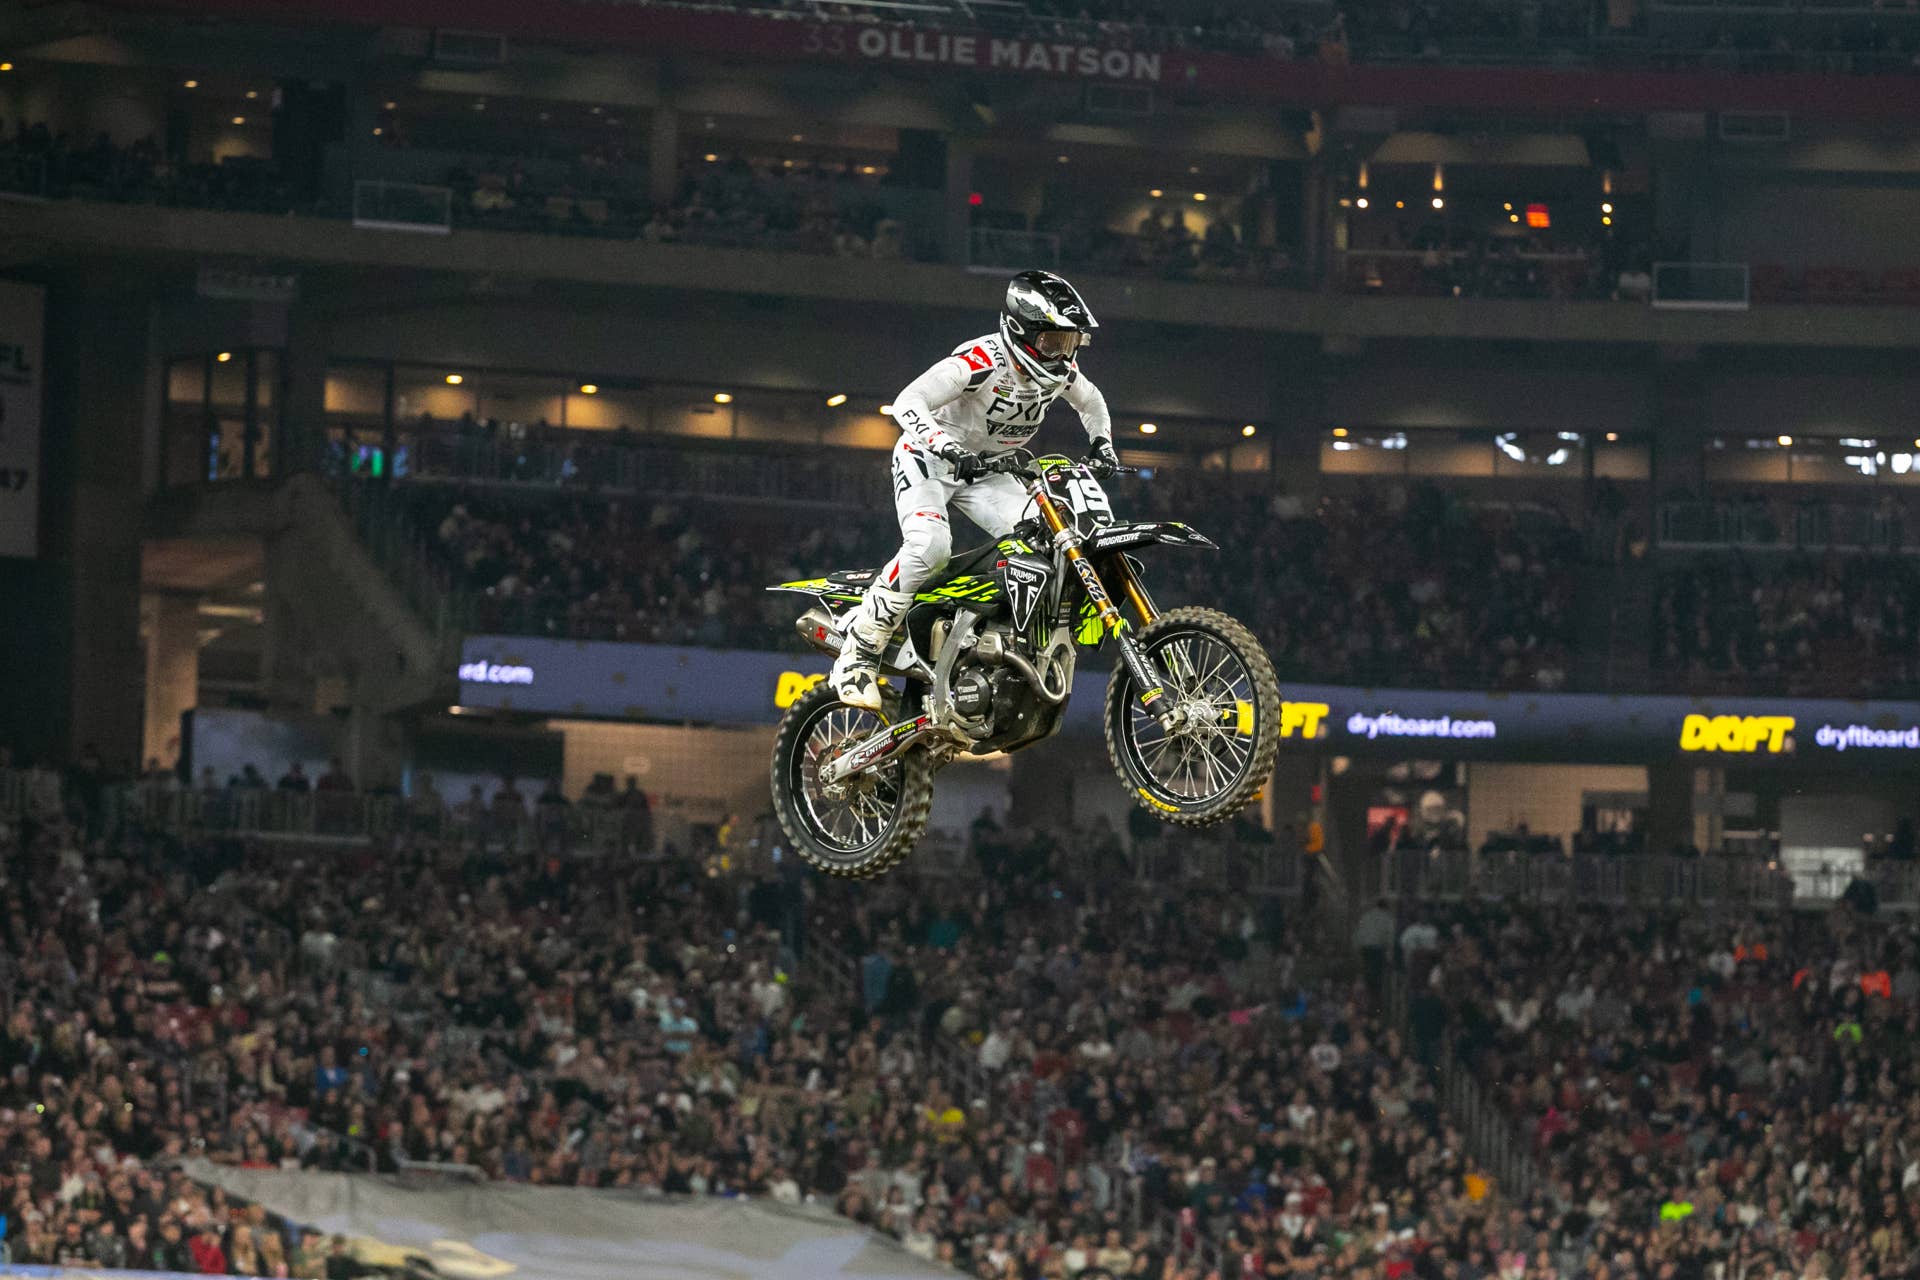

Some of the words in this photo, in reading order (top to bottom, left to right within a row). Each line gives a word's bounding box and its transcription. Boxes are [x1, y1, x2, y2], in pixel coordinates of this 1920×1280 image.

[858, 28, 976, 64] OLLIE
[990, 41, 1162, 81] MATSON
[1065, 479, 1111, 514] 19
[1096, 532, 1141, 547] PROGRESSIVE
[1010, 567, 1037, 582] TRIUMPH
[1347, 712, 1496, 740] dryftboard.com
[1680, 713, 1795, 752] DRYFT
